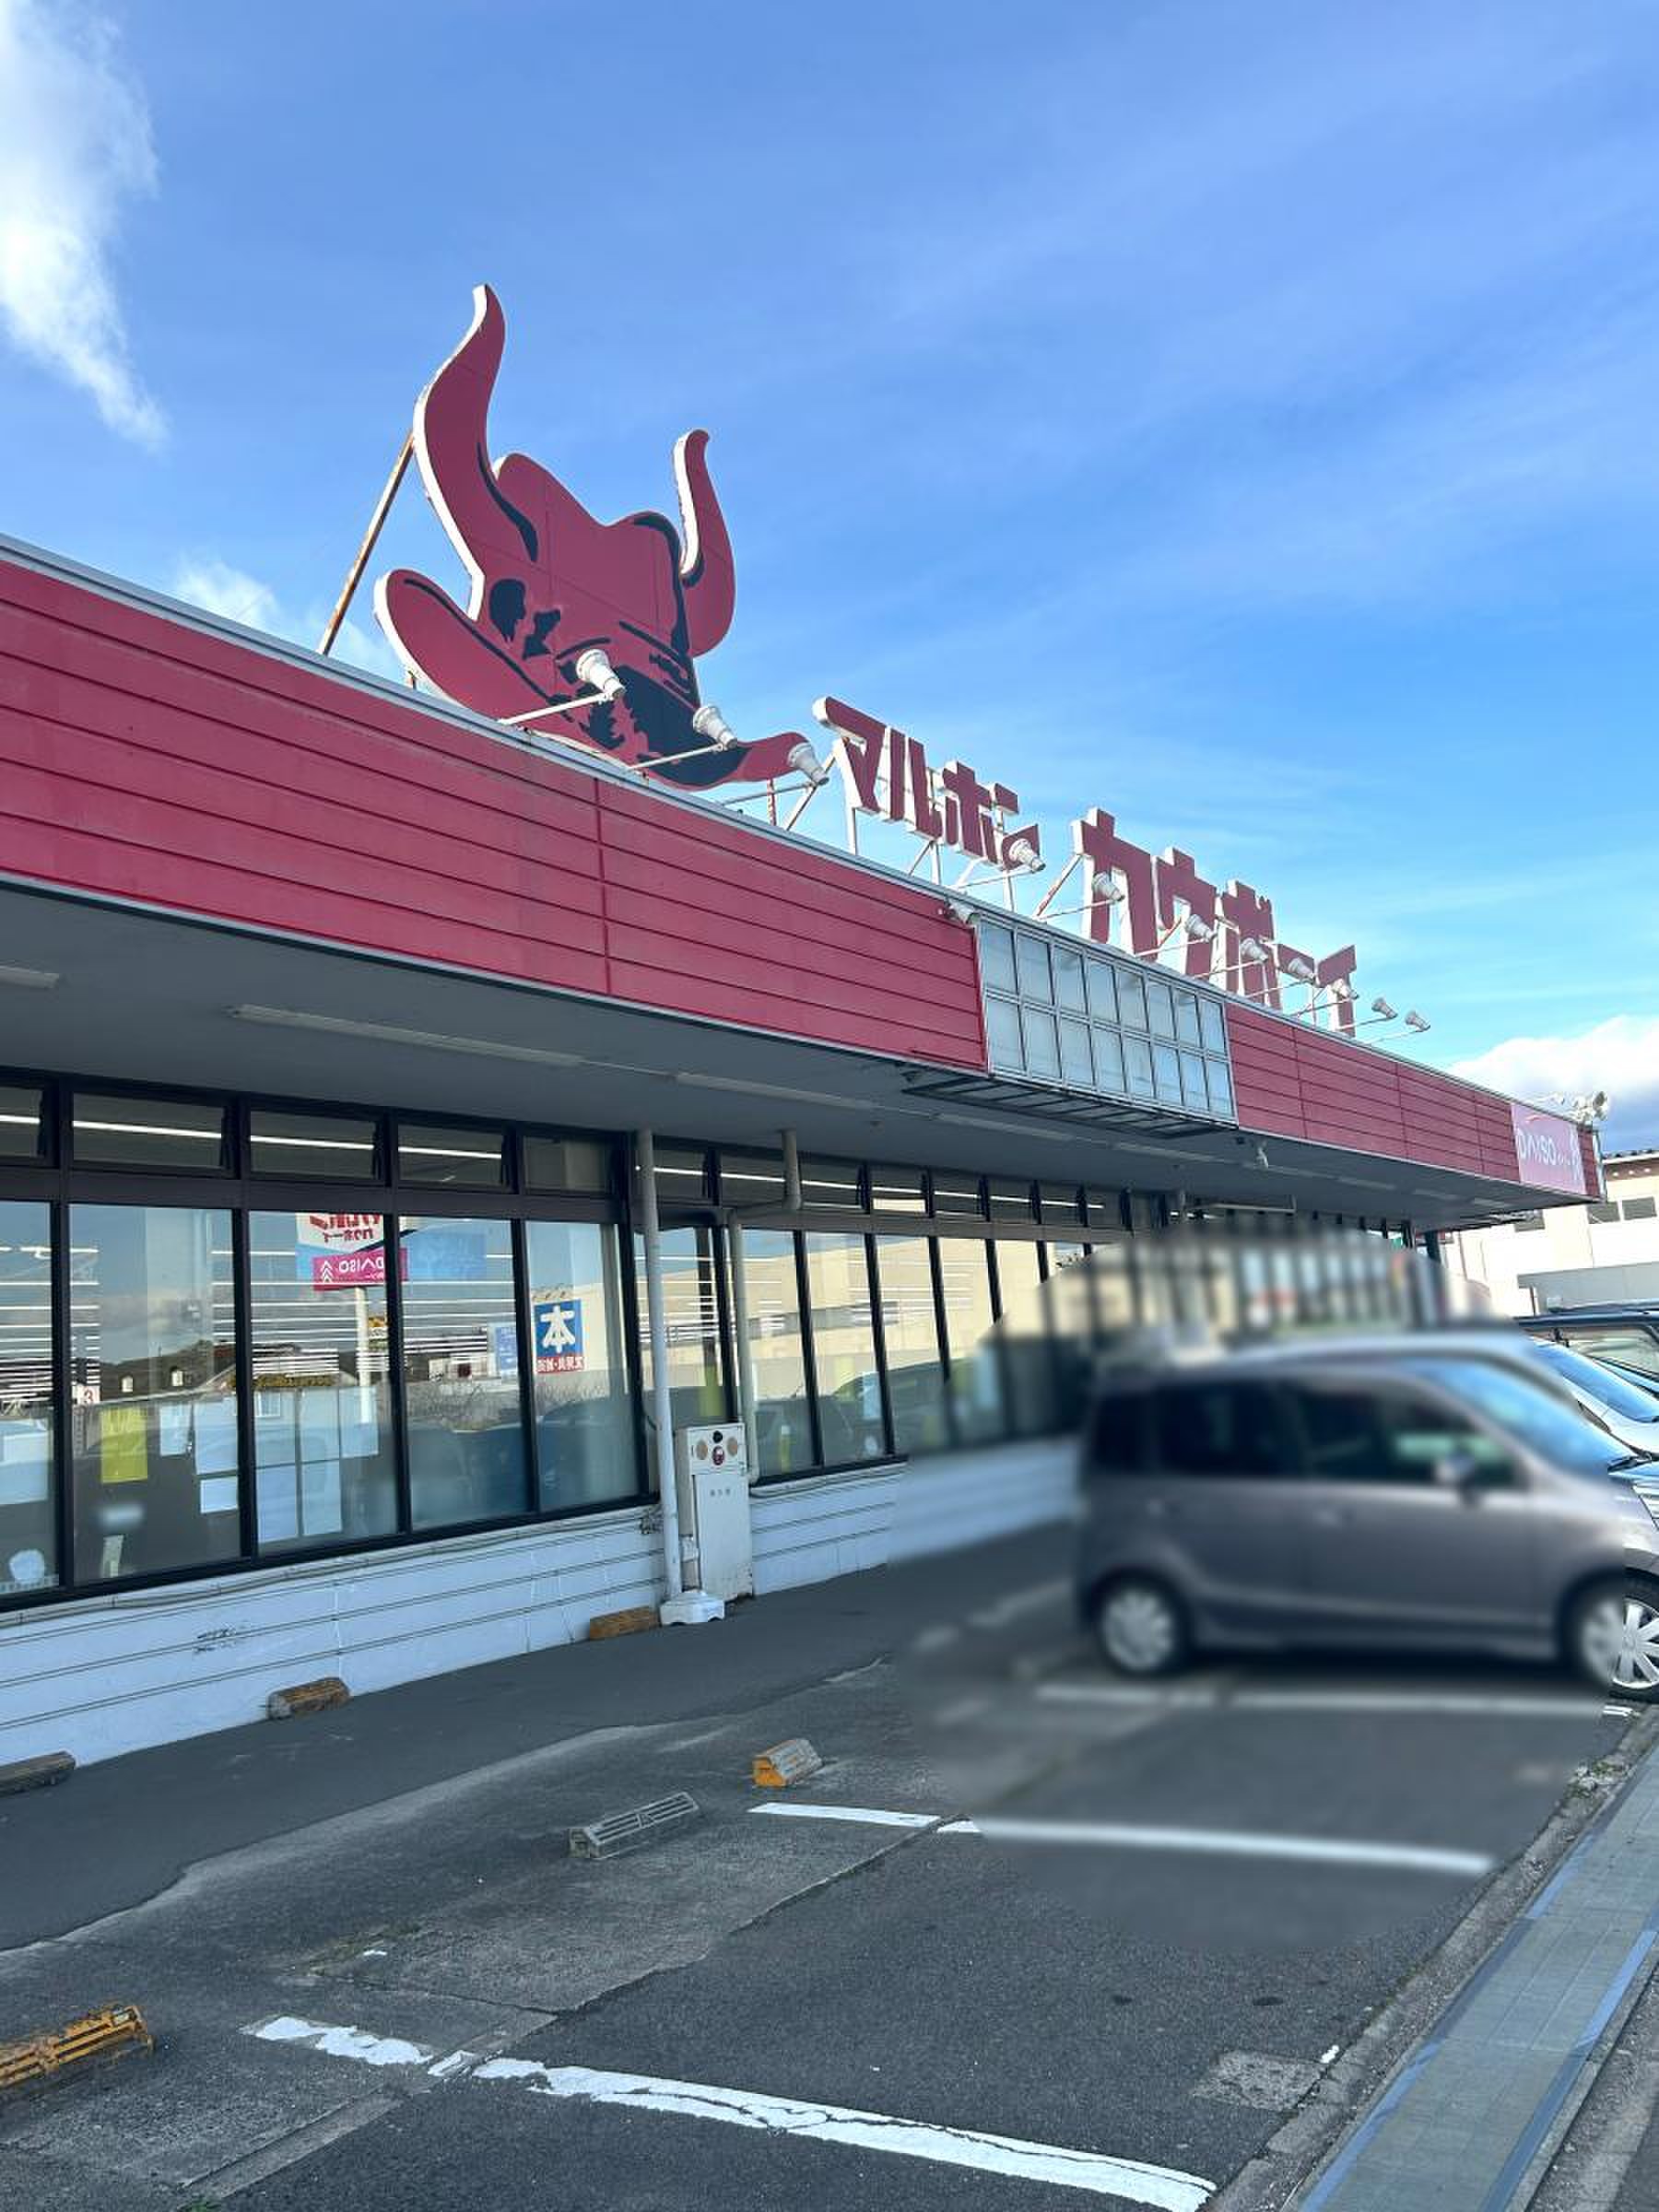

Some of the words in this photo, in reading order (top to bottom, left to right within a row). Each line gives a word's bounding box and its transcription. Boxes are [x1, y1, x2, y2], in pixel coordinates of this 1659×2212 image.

[812, 696, 1041, 865] マルホン
[1071, 806, 1358, 1039] カウボーイ
[540, 1305, 576, 1353] 本
